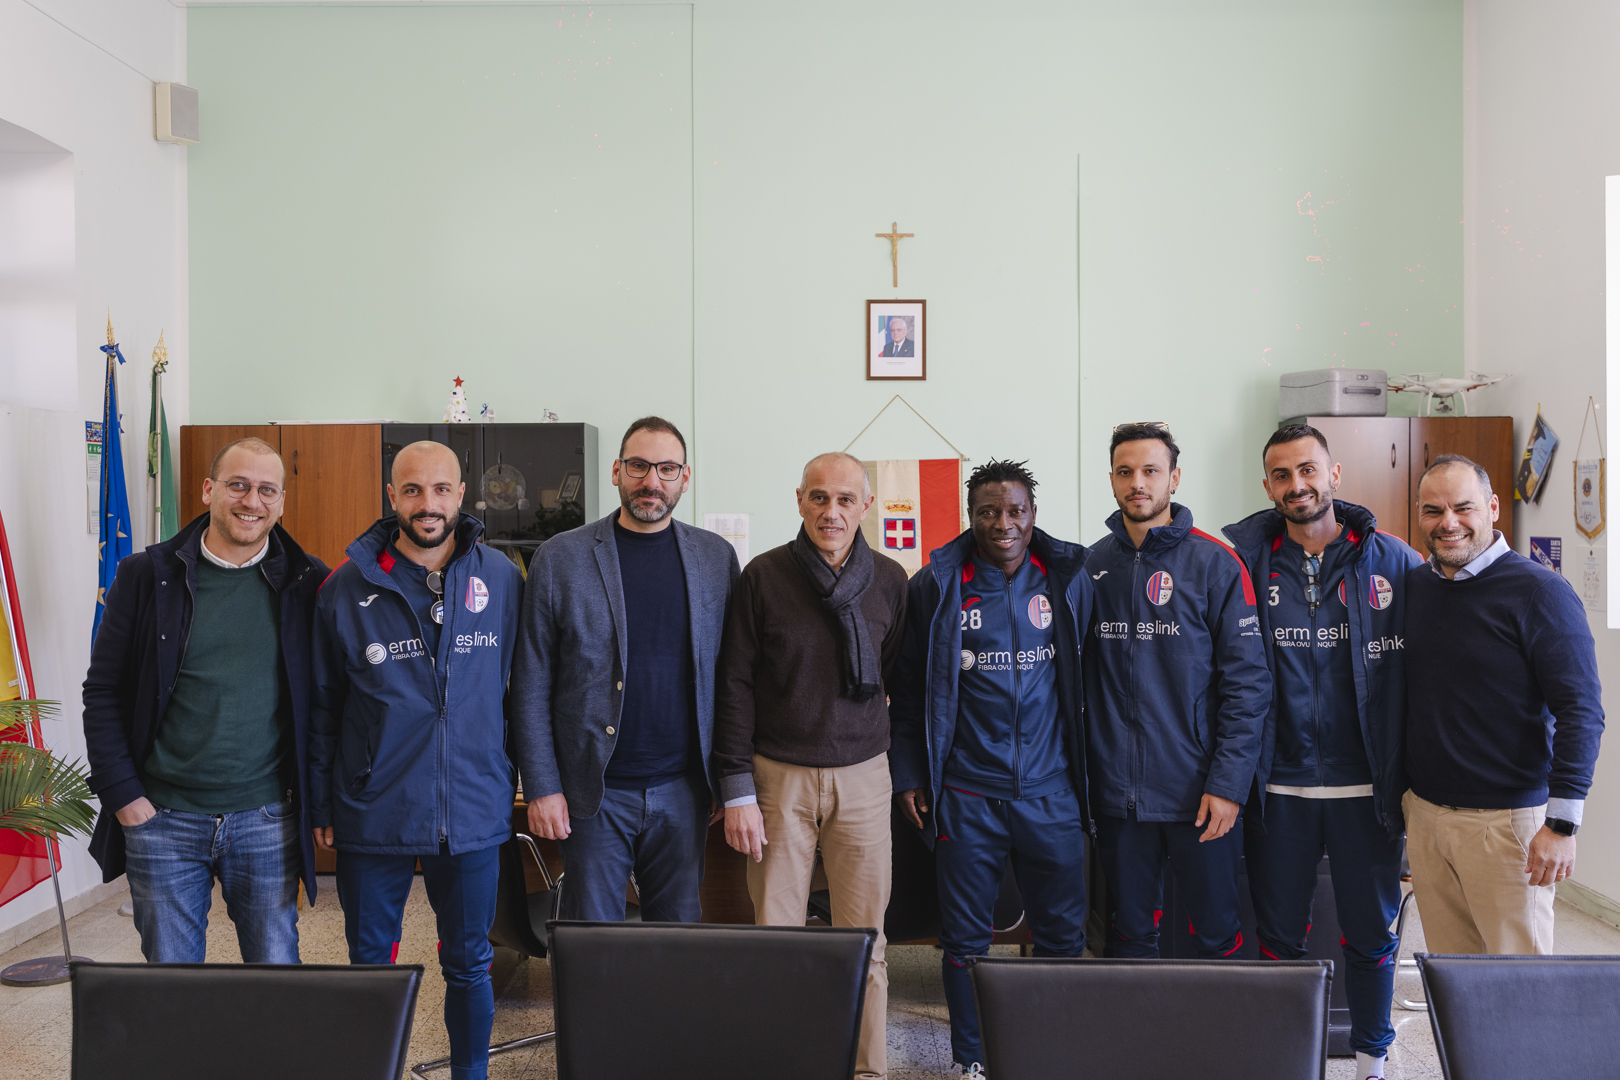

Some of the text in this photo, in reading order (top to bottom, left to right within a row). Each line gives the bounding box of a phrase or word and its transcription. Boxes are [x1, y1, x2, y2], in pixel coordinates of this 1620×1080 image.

[961, 609, 982, 630] 28
[1100, 620, 1180, 636] erm eslink
[1274, 623, 1349, 640] erm esli
[388, 631, 498, 654] erm eslink
[1317, 640, 1337, 648] NQUE
[391, 652, 410, 661] FIBRA
[410, 650, 425, 659] OVU
[977, 651, 1011, 664] erm
